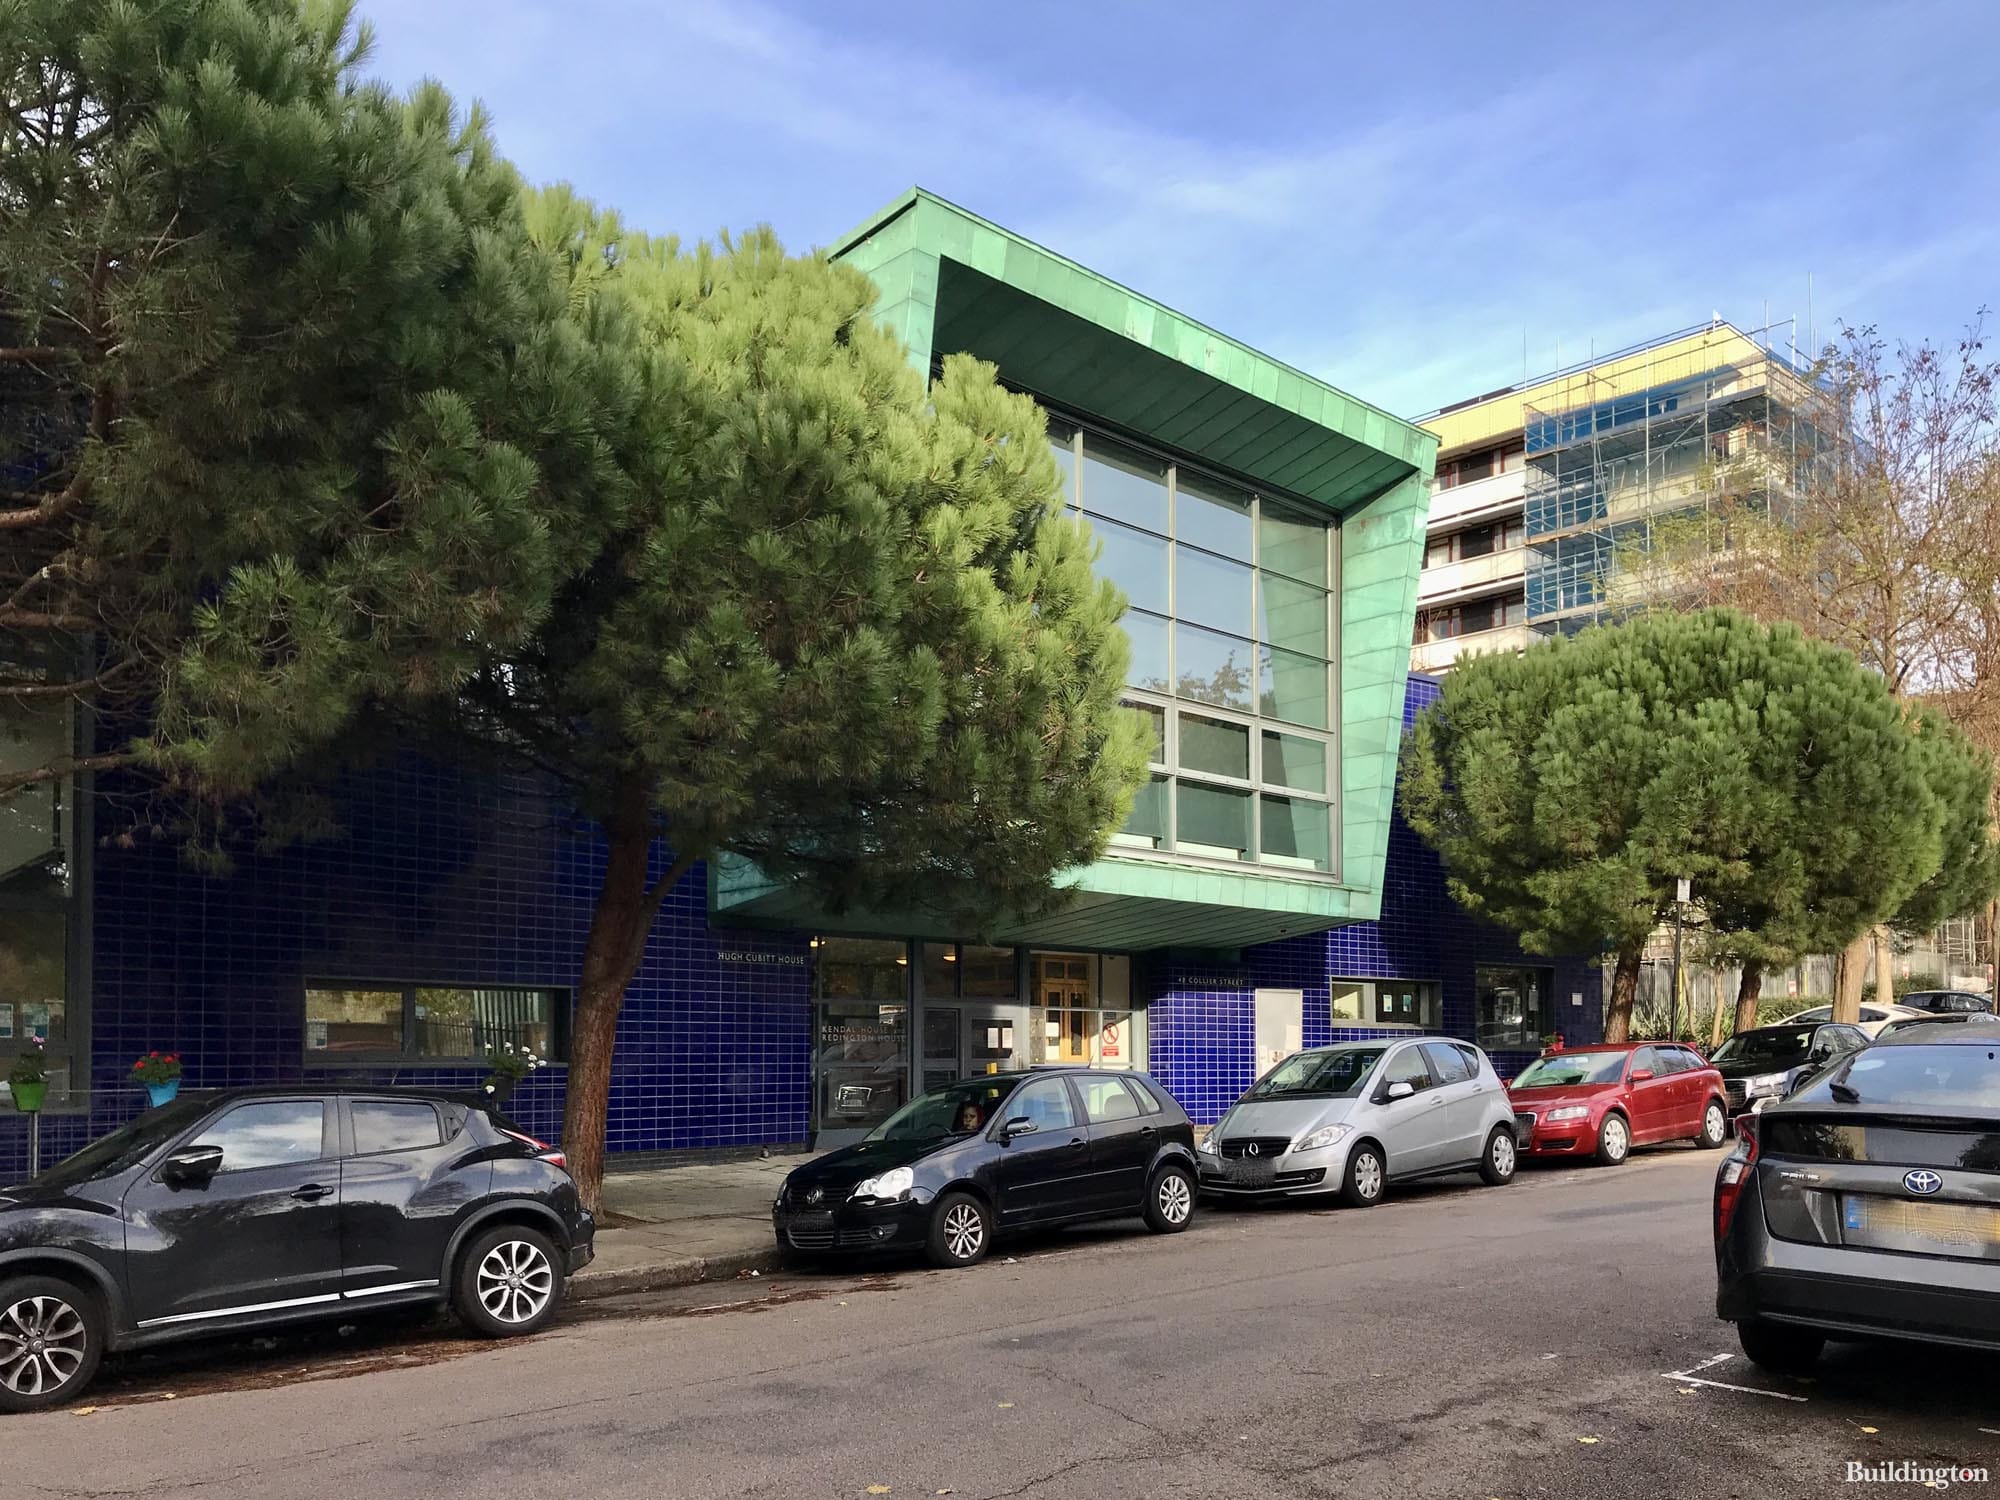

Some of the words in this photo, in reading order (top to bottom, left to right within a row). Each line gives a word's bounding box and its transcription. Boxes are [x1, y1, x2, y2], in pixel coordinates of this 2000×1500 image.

[717, 952, 743, 961] HUGH
[745, 953, 776, 962] CUBITT
[778, 955, 804, 965] HOUSE
[1188, 977, 1218, 985] COLLIER
[822, 1025, 856, 1033] KENDAL
[822, 1034, 874, 1042] REDINGTON
